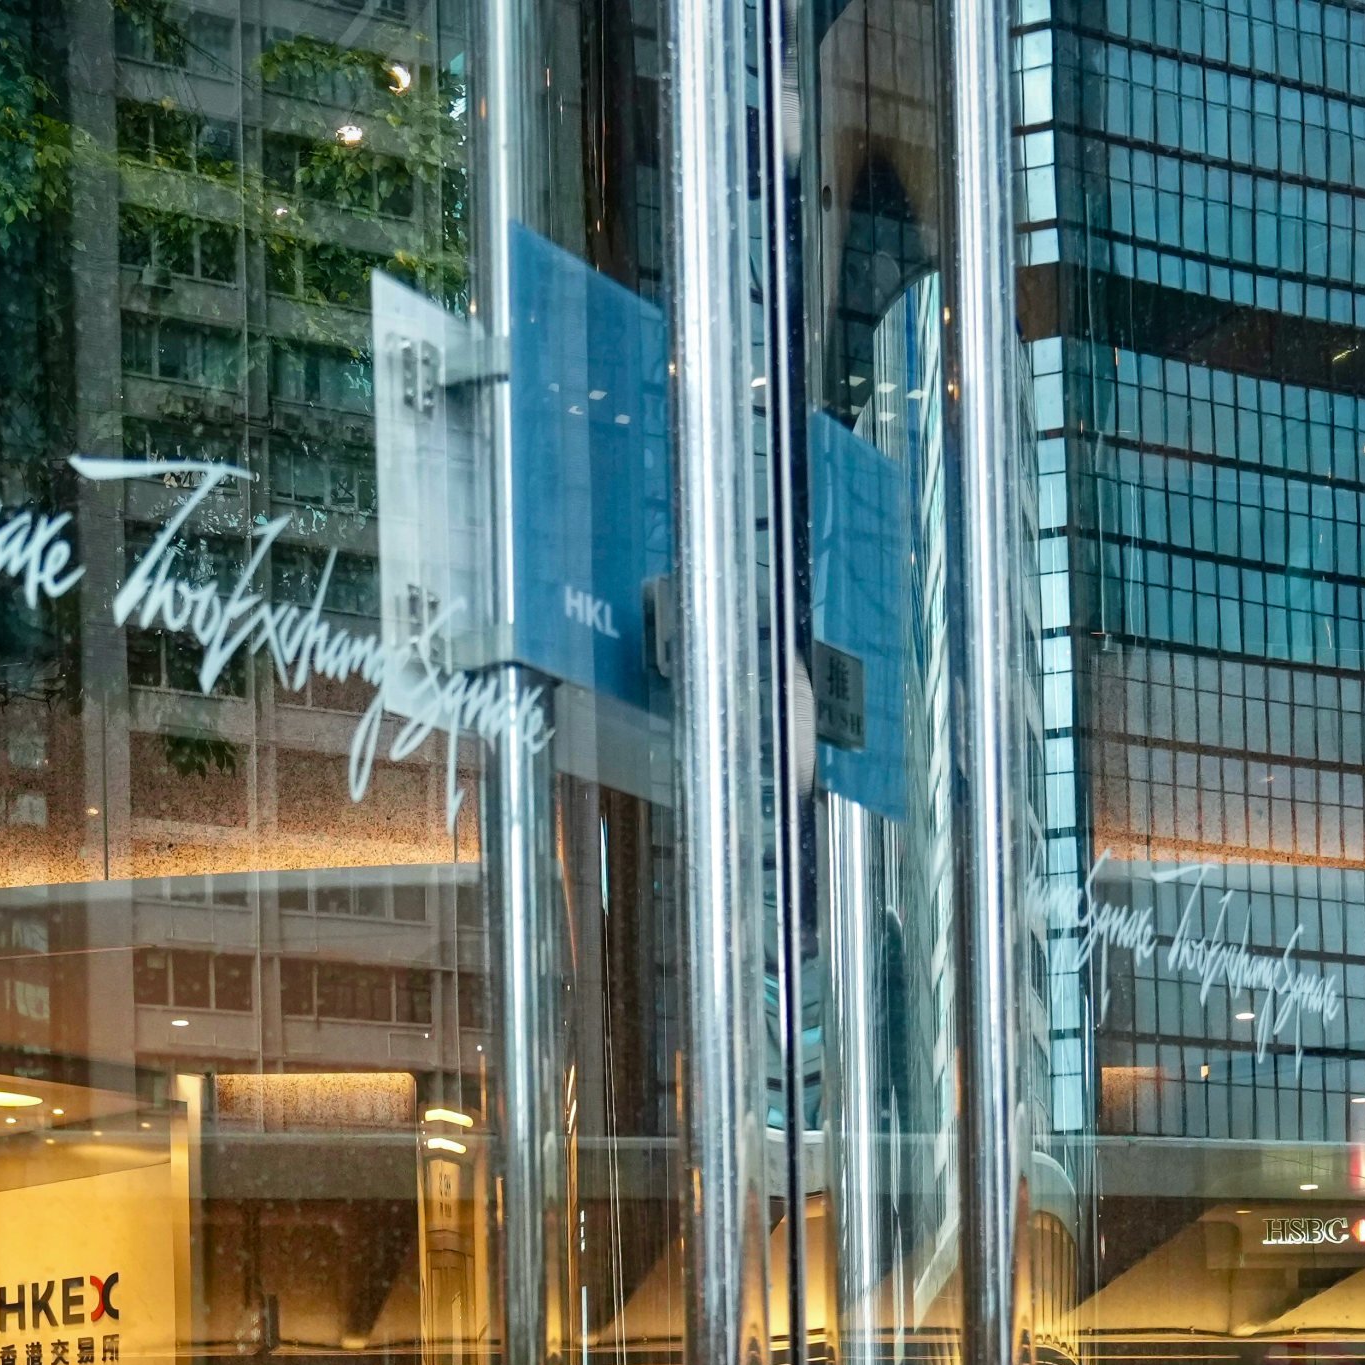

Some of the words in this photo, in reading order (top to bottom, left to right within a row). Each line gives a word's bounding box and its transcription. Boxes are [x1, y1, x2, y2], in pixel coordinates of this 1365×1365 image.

[67, 454, 257, 647] Two
[564, 585, 620, 639] HKL
[1261, 1217, 1350, 1245] HSBC
